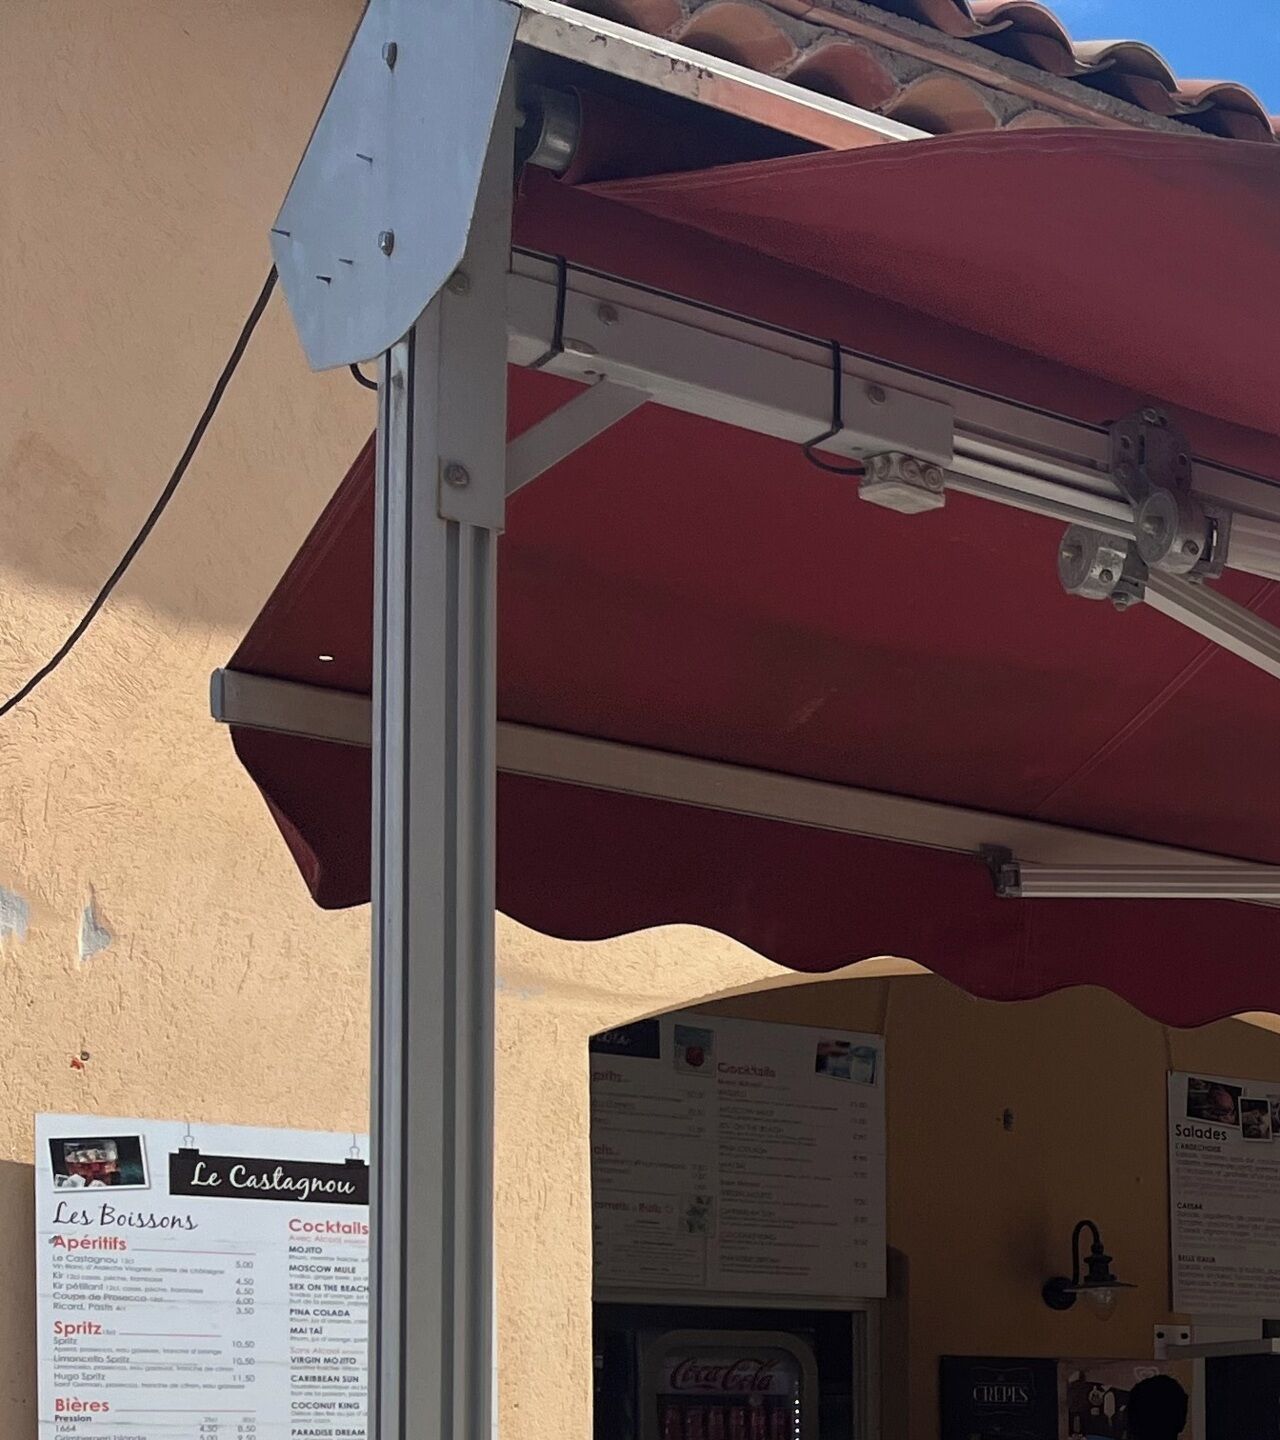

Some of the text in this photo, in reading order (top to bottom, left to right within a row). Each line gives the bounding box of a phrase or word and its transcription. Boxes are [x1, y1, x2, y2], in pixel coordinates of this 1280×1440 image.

[1175, 1124, 1228, 1141] Salades
[191, 1162, 356, 1199] Le Castagnou
[53, 1201, 199, 1231] Les Boissons
[289, 1219, 369, 1236] Cocktails
[53, 1235, 127, 1252] Apéritifs
[289, 1246, 323, 1255] MOJITO
[289, 1265, 356, 1274] MOSCOW MULE
[289, 1284, 305, 1292] SEX
[308, 1284, 322, 1292] ON
[323, 1285, 339, 1293] THE
[312, 1309, 350, 1318] COLADA
[54, 1321, 102, 1339] Spritz
[55, 1397, 110, 1412] Bières
[291, 1401, 361, 1411] COCONUT KING
